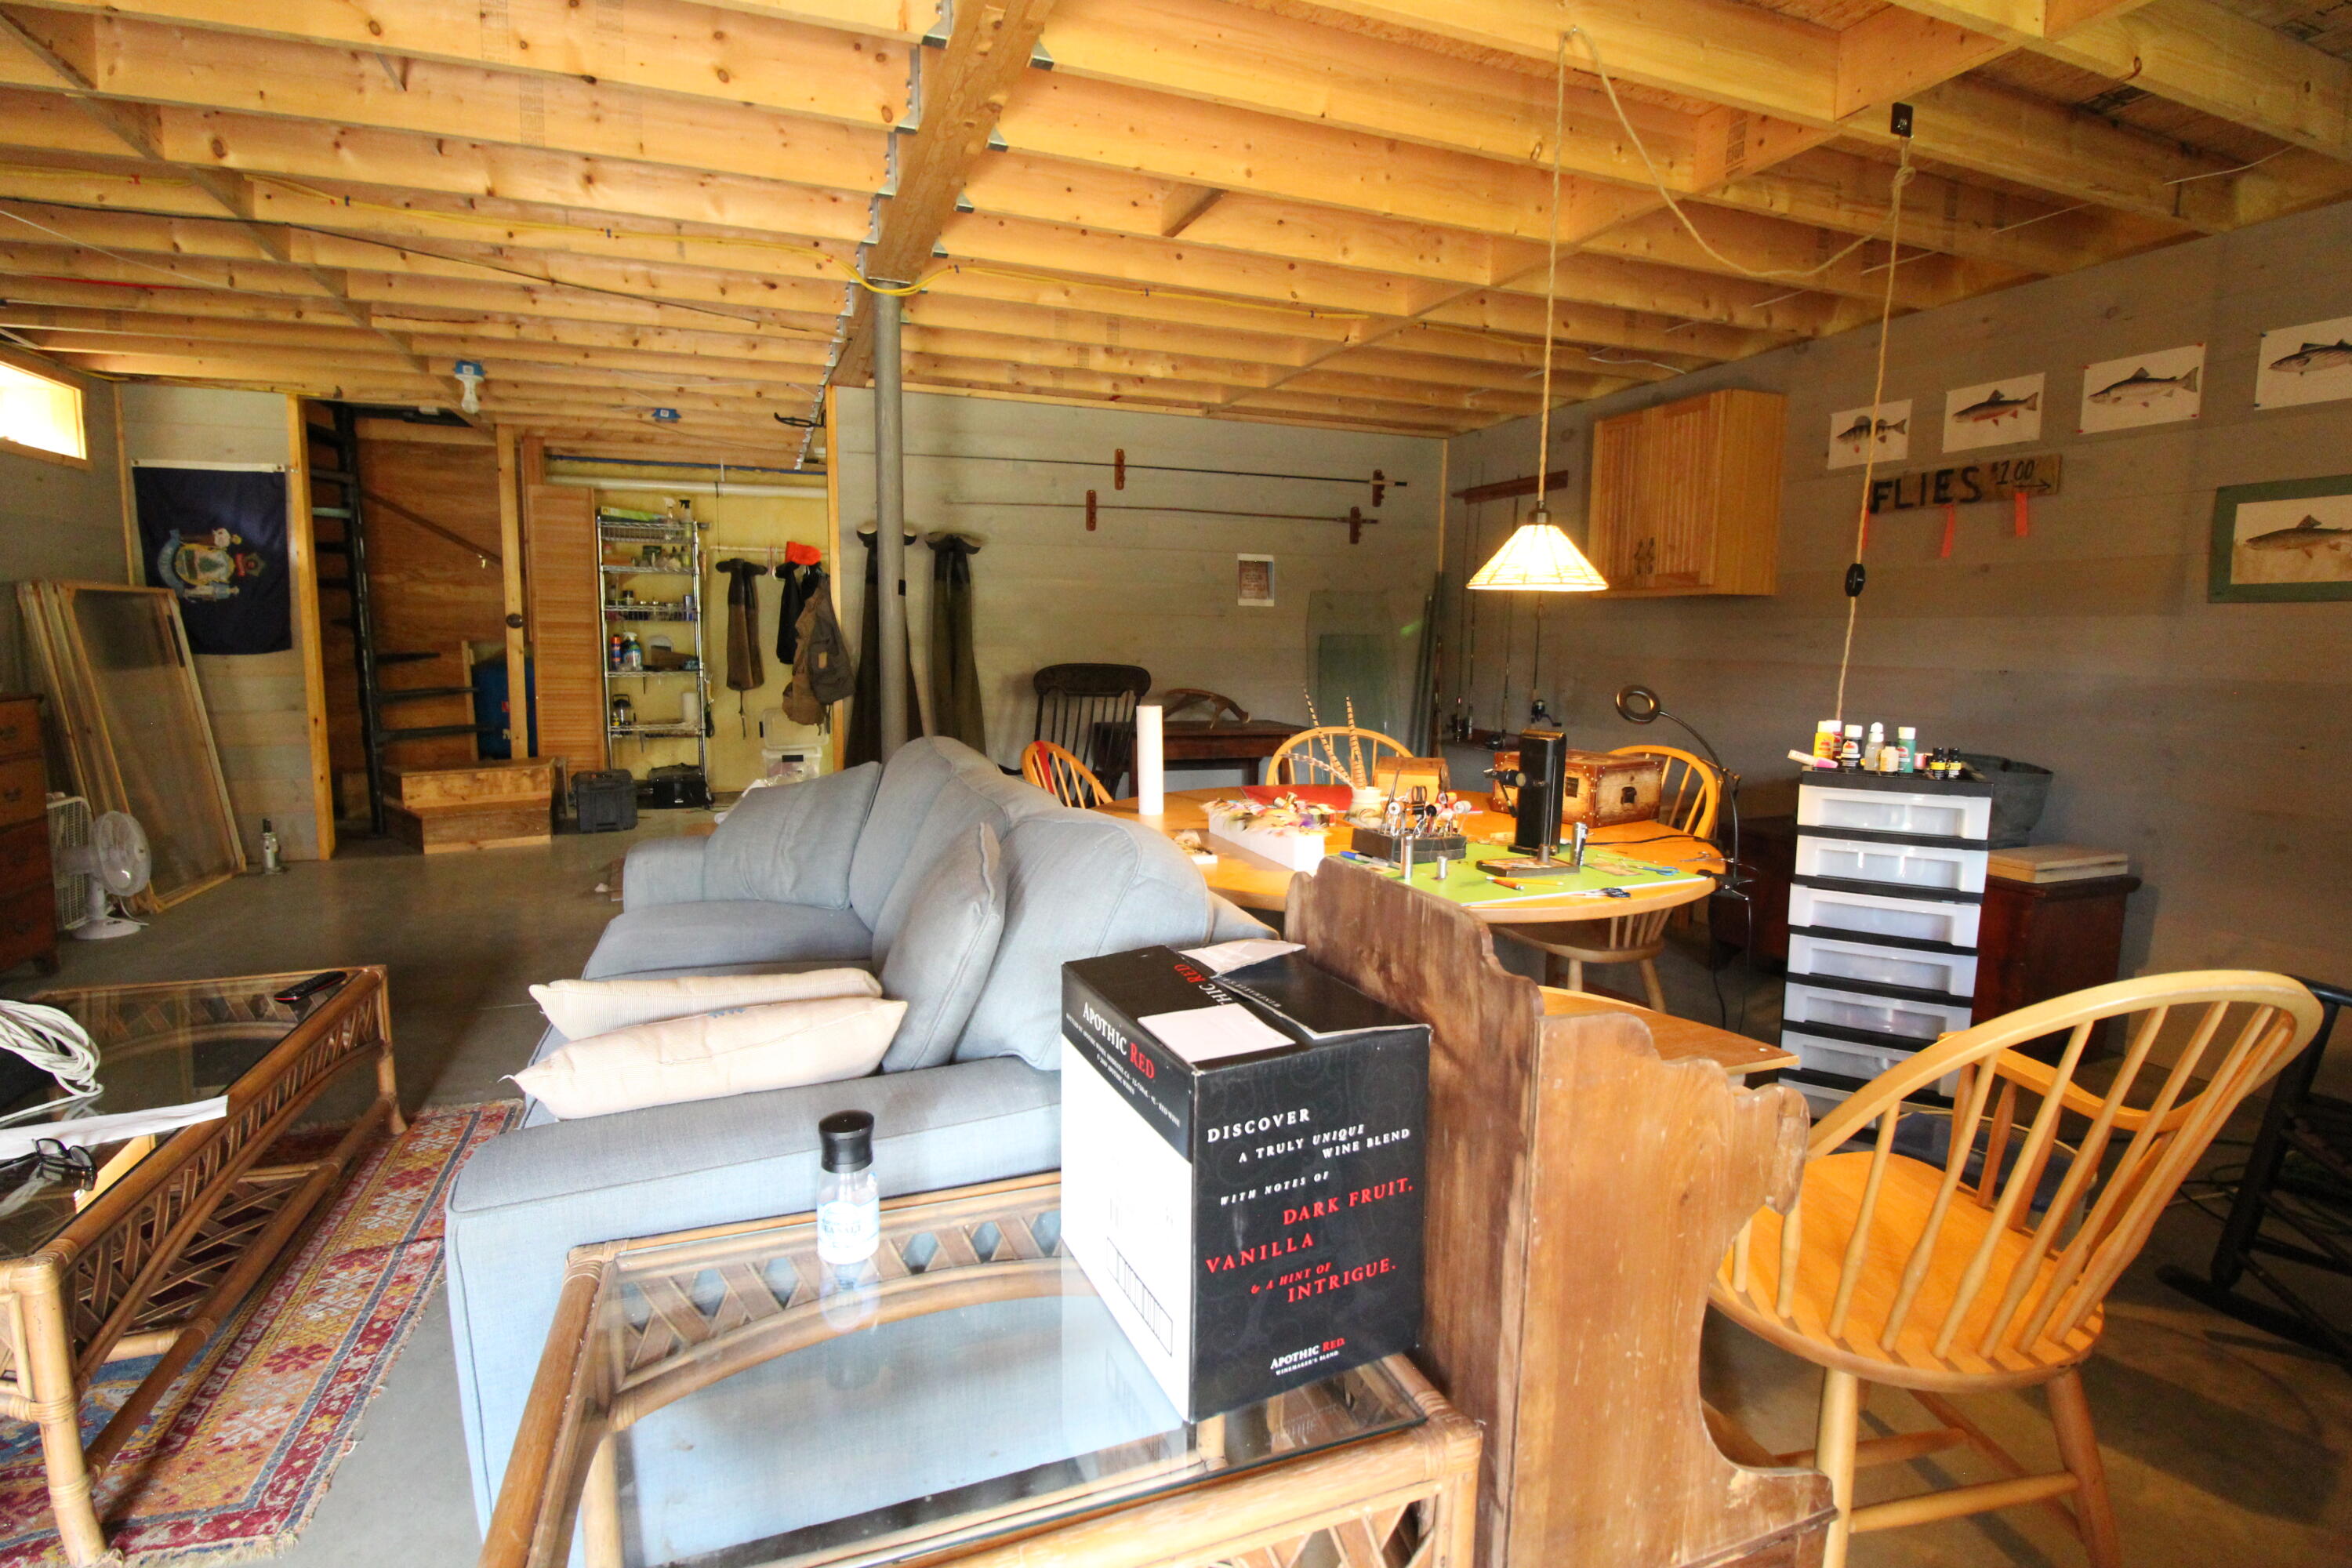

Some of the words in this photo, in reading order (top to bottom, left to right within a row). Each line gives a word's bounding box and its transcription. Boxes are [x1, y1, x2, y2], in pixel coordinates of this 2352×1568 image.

[1869, 466, 1983, 514] FLIES
[1174, 964, 1206, 983] RED
[1083, 1001, 1127, 1056] APOTHIC
[1130, 1042, 1156, 1079] RED
[1207, 1108, 1311, 1142] DISCOVER
[1238, 1152, 1247, 1163] A
[1255, 1138, 1305, 1160] TRULY
[1312, 1123, 1365, 1145] UNIQUE
[1322, 1141, 1360, 1159] WINE
[1367, 1128, 1410, 1149] BLEND
[1220, 1189, 1256, 1206] WITH
[1265, 1177, 1306, 1196] NOTES
[1314, 1171, 1330, 1183] OF
[1283, 1197, 1340, 1225] DARK
[1348, 1178, 1414, 1207] FRUIT.
[1205, 1232, 1314, 1273] VANILLA
[1250, 1284, 1260, 1294] &
[1265, 1279, 1274, 1290] A
[1279, 1268, 1312, 1286] HINT
[1316, 1261, 1332, 1275] OF
[1287, 1258, 1396, 1303] INTRIGUE.
[1270, 1345, 1319, 1370] APOTHIC
[1276, 1357, 1318, 1376] WINEMAKER'S
[1319, 1350, 1339, 1361] BLEND
